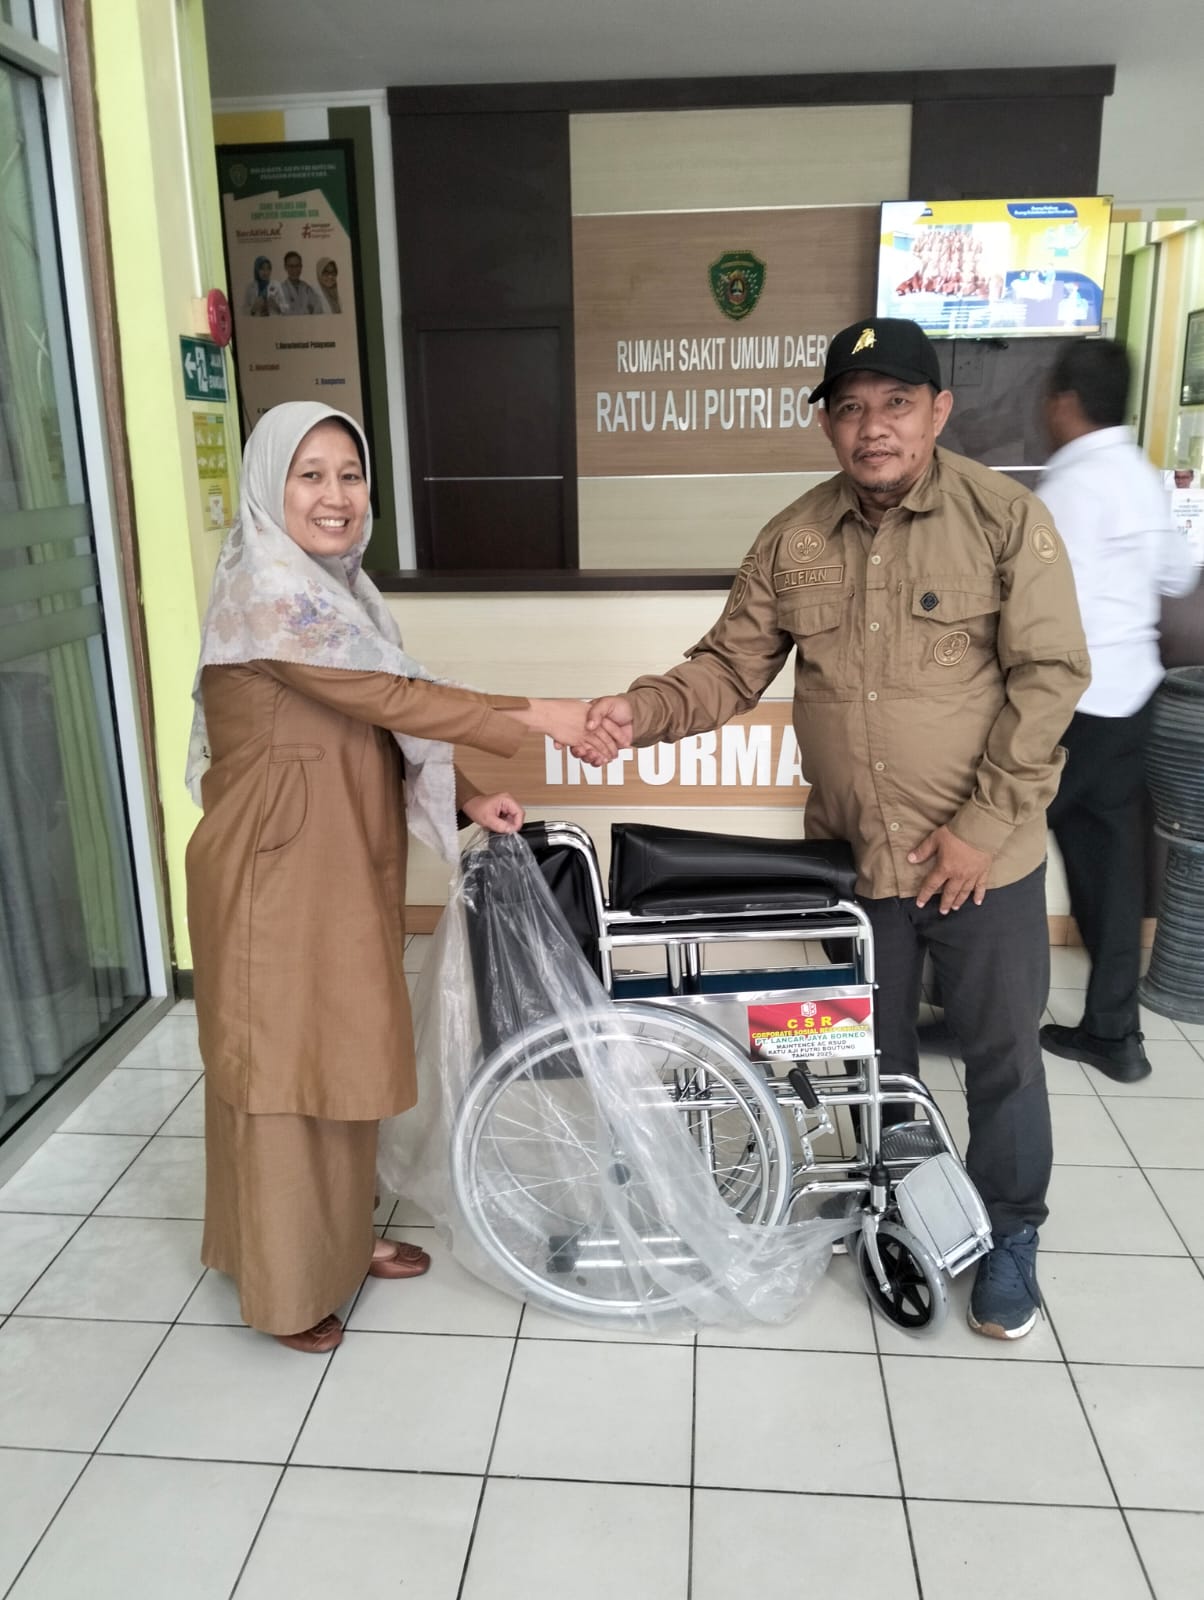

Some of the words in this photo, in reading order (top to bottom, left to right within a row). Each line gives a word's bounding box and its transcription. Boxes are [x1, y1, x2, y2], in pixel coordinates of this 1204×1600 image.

[617, 339, 674, 373] RUMAH
[678, 337, 726, 372] SAKIT
[730, 335, 780, 370] UMUM
[597, 391, 657, 433] RATU
[661, 390, 697, 432] AJI
[704, 387, 773, 430] PUTRI
[779, 386, 825, 429] BO
[783, 569, 828, 587] ALFIAN
[752, 1030, 792, 1039] CORPORATE
[771, 1036, 805, 1044] LANCAR
[807, 1033, 828, 1042] JAYA
[830, 1031, 866, 1039] BORNEO
